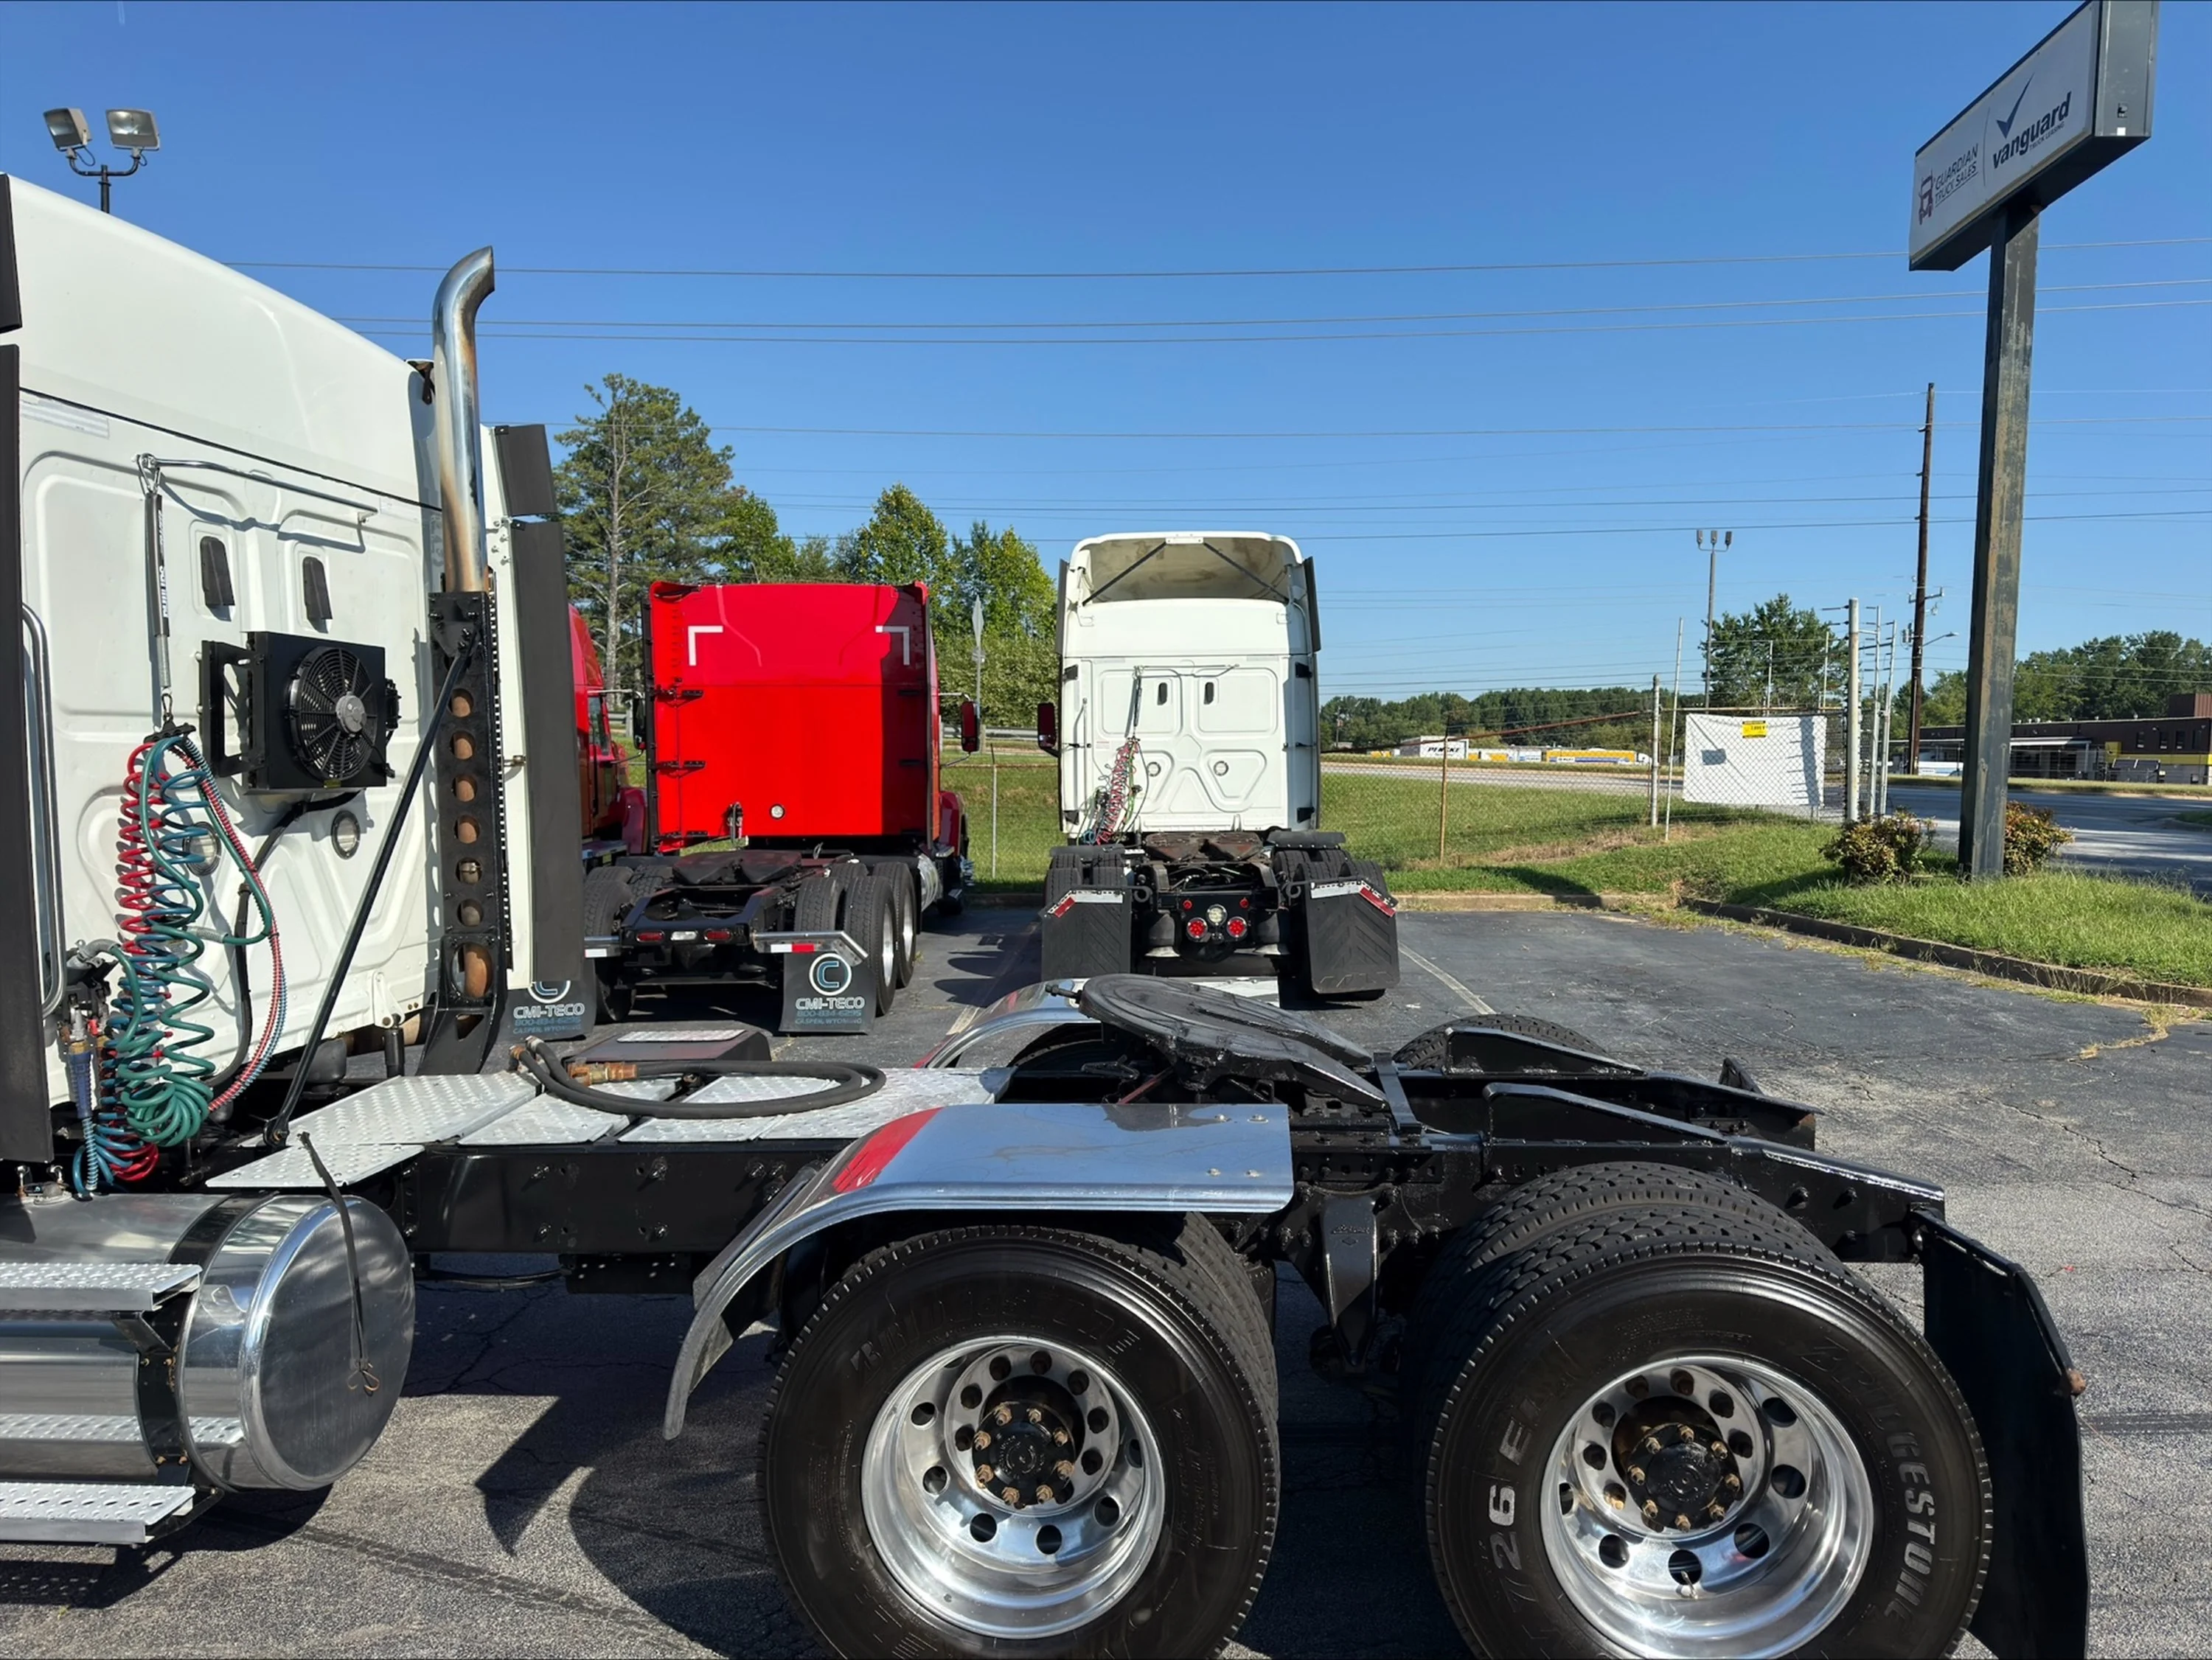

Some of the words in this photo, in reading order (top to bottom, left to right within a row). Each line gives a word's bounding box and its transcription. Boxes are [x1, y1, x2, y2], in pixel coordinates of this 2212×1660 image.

[1992, 91, 2072, 169] vanguard
[1935, 142, 1978, 190] GUARDIAN
[1935, 180, 1954, 204] TRUCK
[1955, 160, 1977, 187] SALES
[513, 1002, 585, 1019] CMI-TECO
[795, 996, 866, 1010] CMI-TECO
